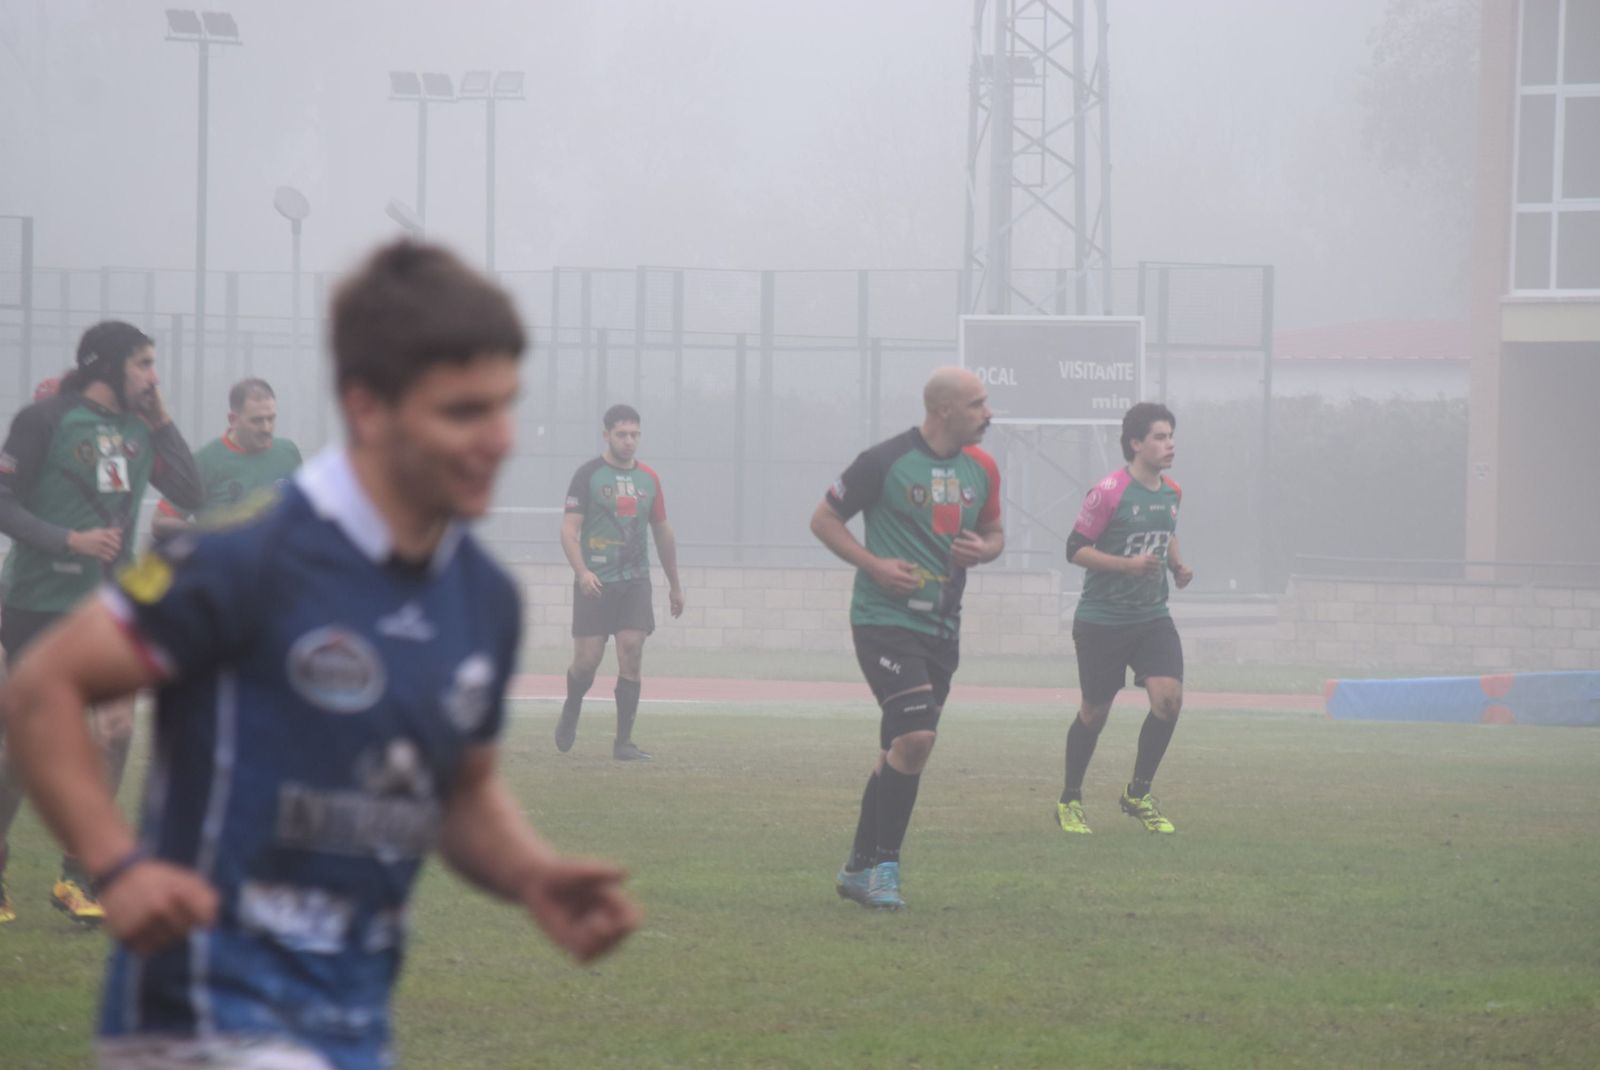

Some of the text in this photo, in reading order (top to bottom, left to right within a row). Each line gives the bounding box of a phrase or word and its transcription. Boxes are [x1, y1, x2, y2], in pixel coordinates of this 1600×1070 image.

[969, 366, 1017, 385] OCAL
[1059, 361, 1134, 381] VISITANTE
[1091, 393, 1131, 409] min
